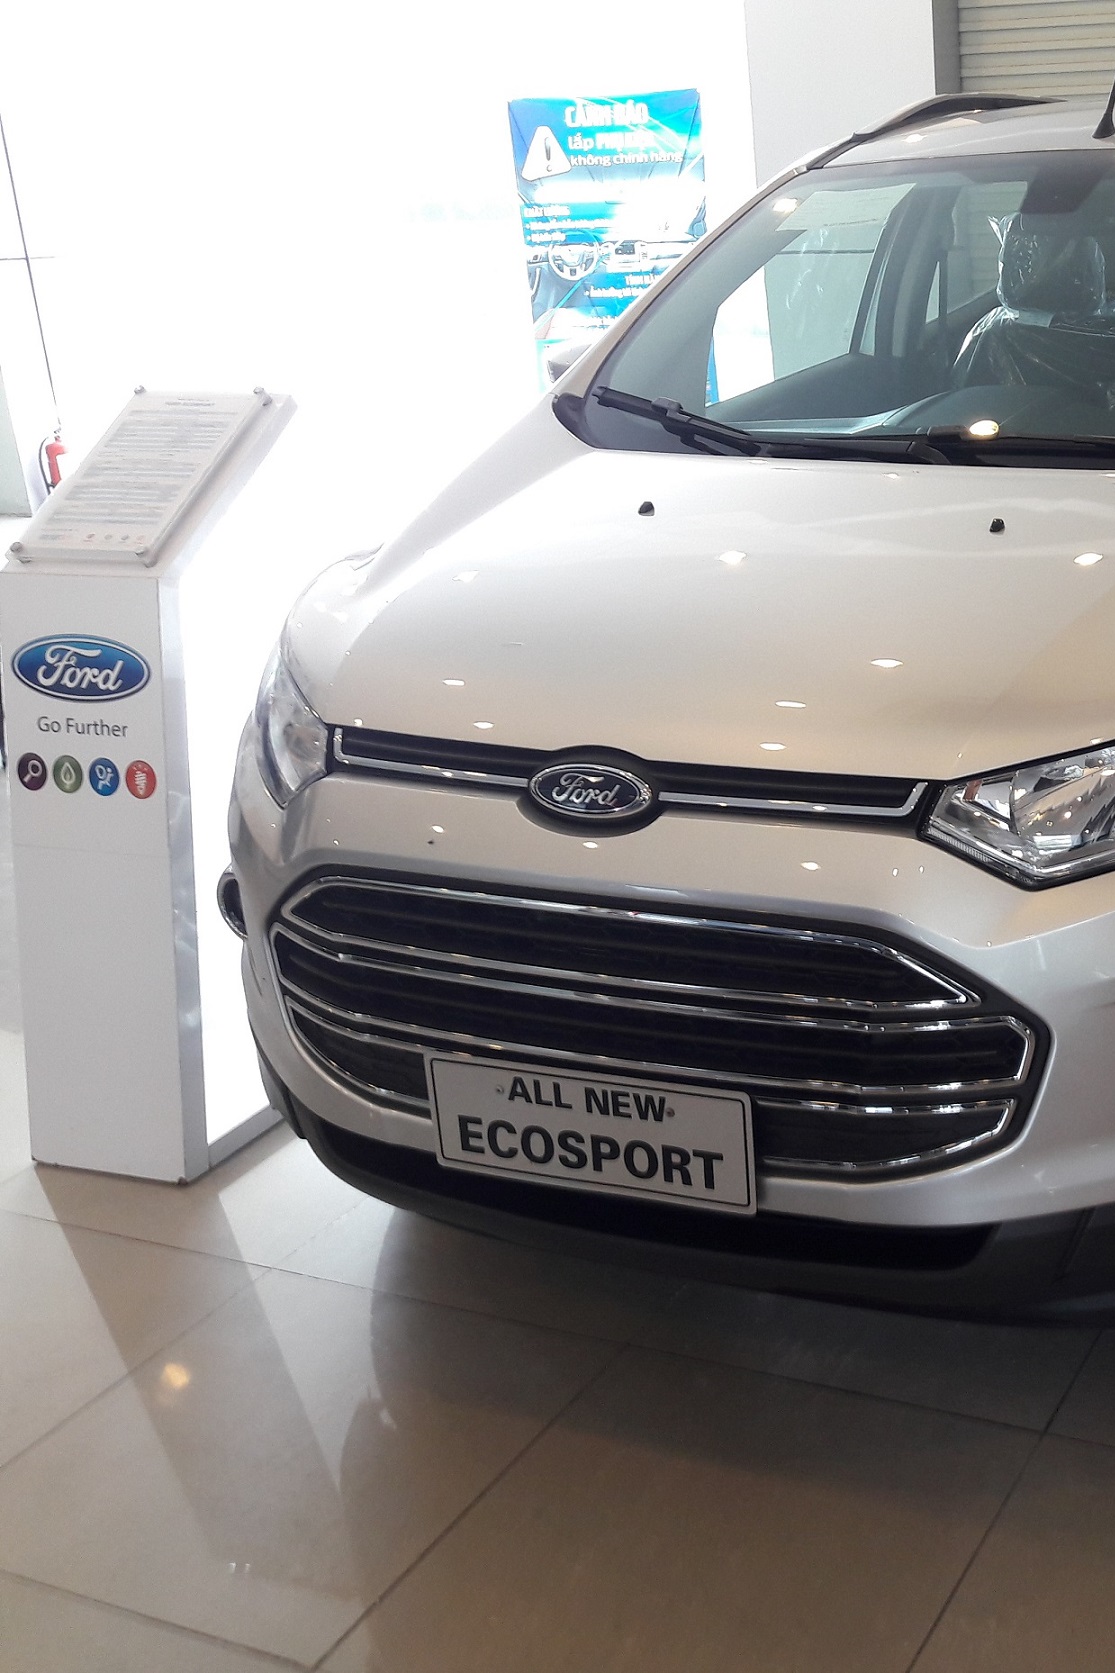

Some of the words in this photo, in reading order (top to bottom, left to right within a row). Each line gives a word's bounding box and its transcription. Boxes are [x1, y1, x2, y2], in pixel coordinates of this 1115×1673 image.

[571, 154, 611, 167] không
[37, 645, 124, 691] Ford
[38, 716, 62, 733] Go
[66, 717, 128, 738] Further
[552, 772, 621, 806] Ford
[508, 1076, 572, 1109] ALL
[584, 1087, 666, 1122] NEW
[457, 1114, 724, 1190] ECOSPORT
